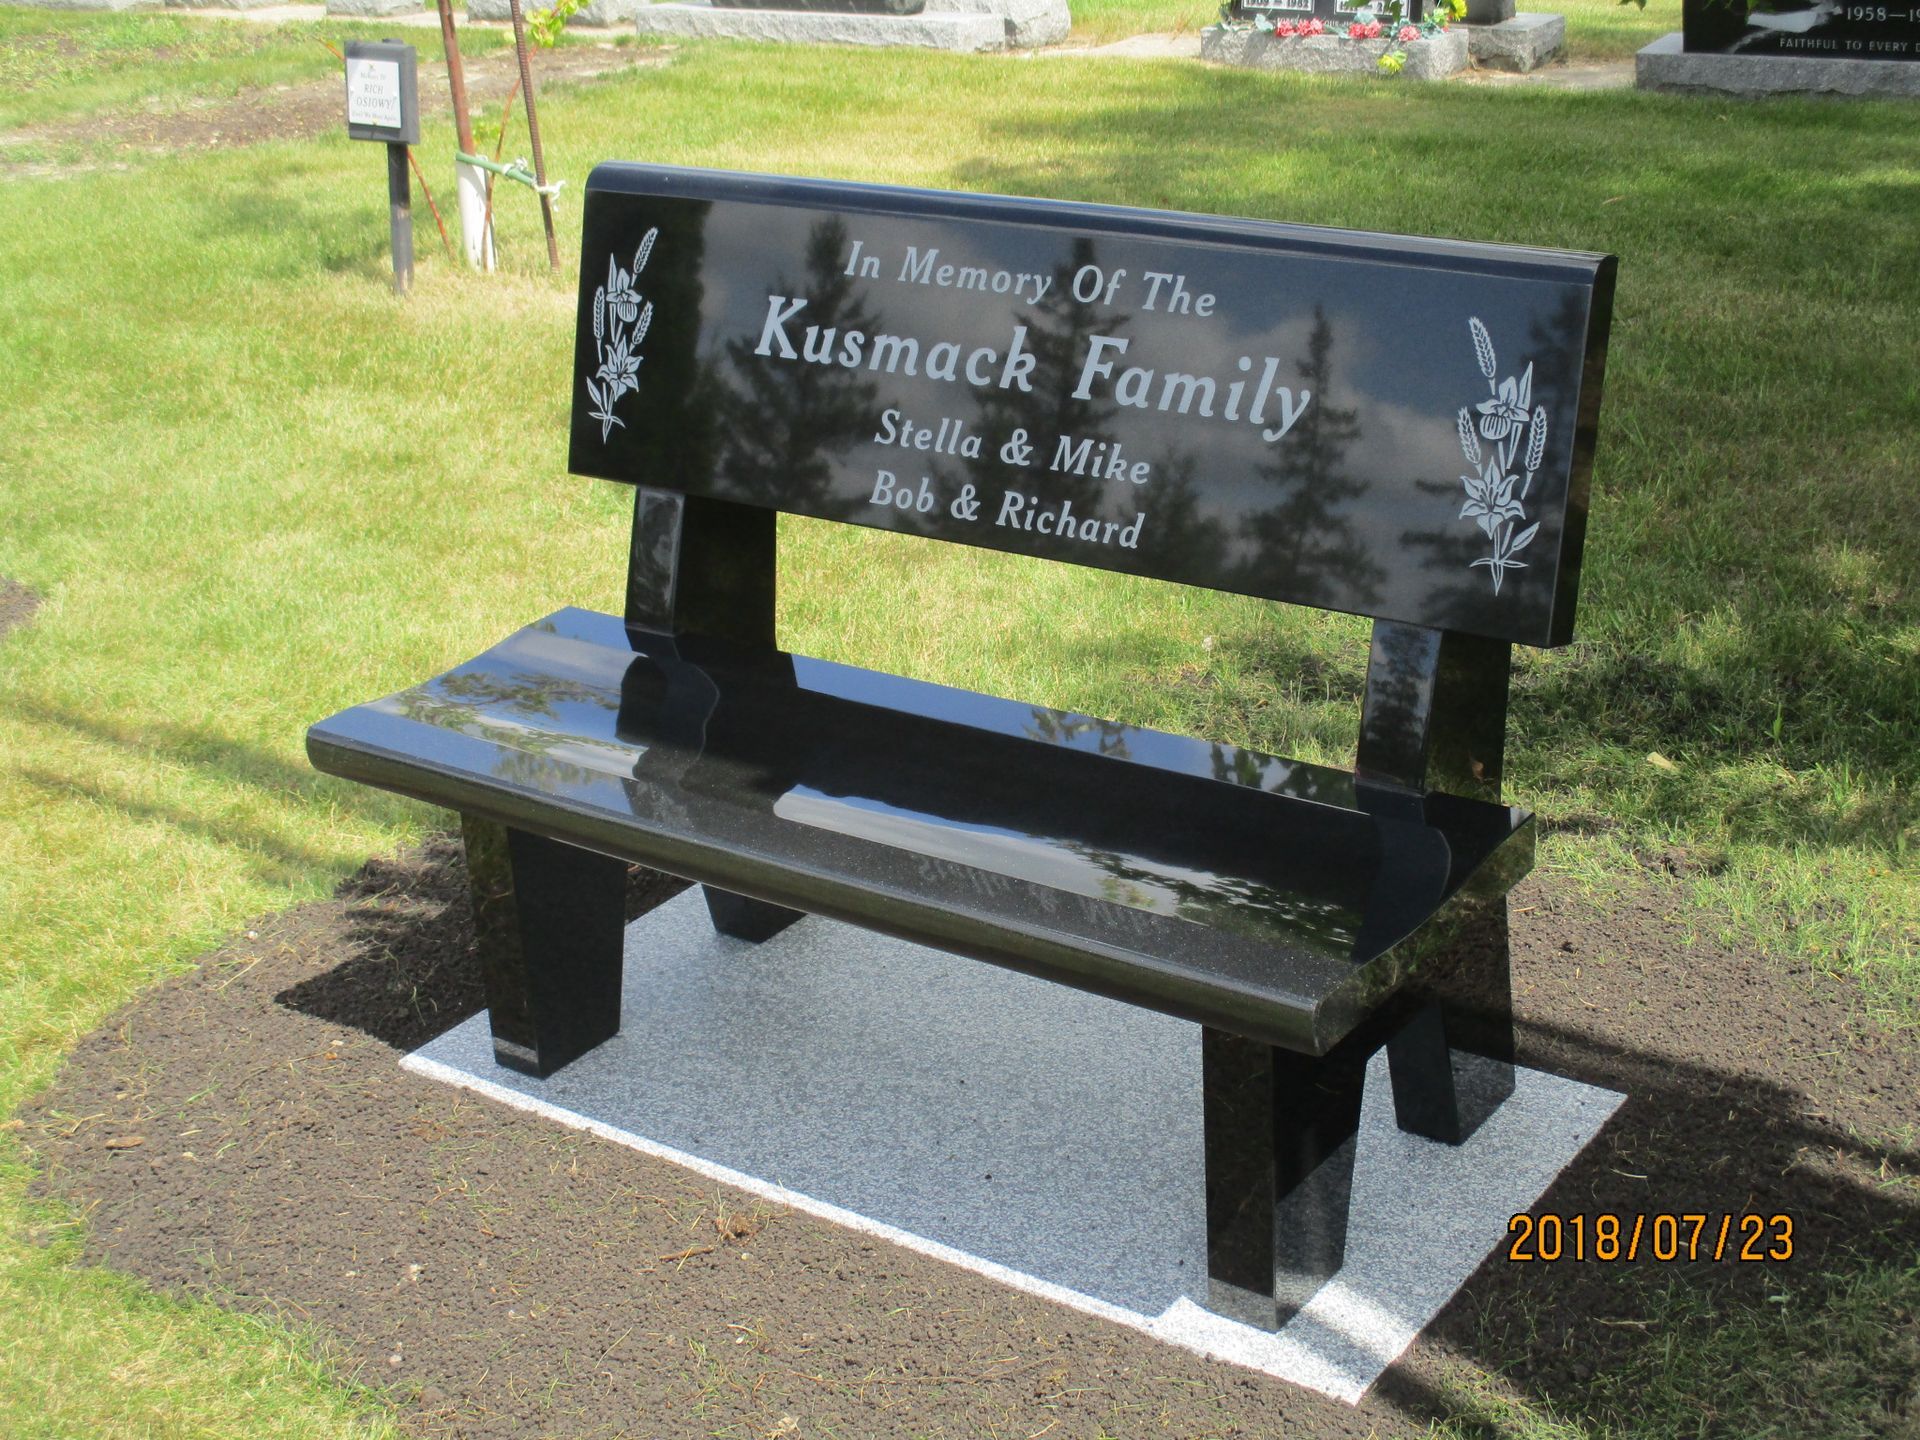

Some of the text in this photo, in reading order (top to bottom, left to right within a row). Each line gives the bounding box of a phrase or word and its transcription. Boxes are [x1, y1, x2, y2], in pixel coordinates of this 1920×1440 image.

[1779, 38, 1837, 50] FAITHFUL
[1845, 40, 1862, 50] TO
[1869, 41, 1908, 52] EVERY
[364, 83, 384, 95] RICH
[843, 240, 1217, 318] In Memory Of The
[753, 294, 1312, 443] Kusmack Family
[874, 408, 1152, 485] Stella & Mike
[868, 470, 1147, 550] Bob & Richard
